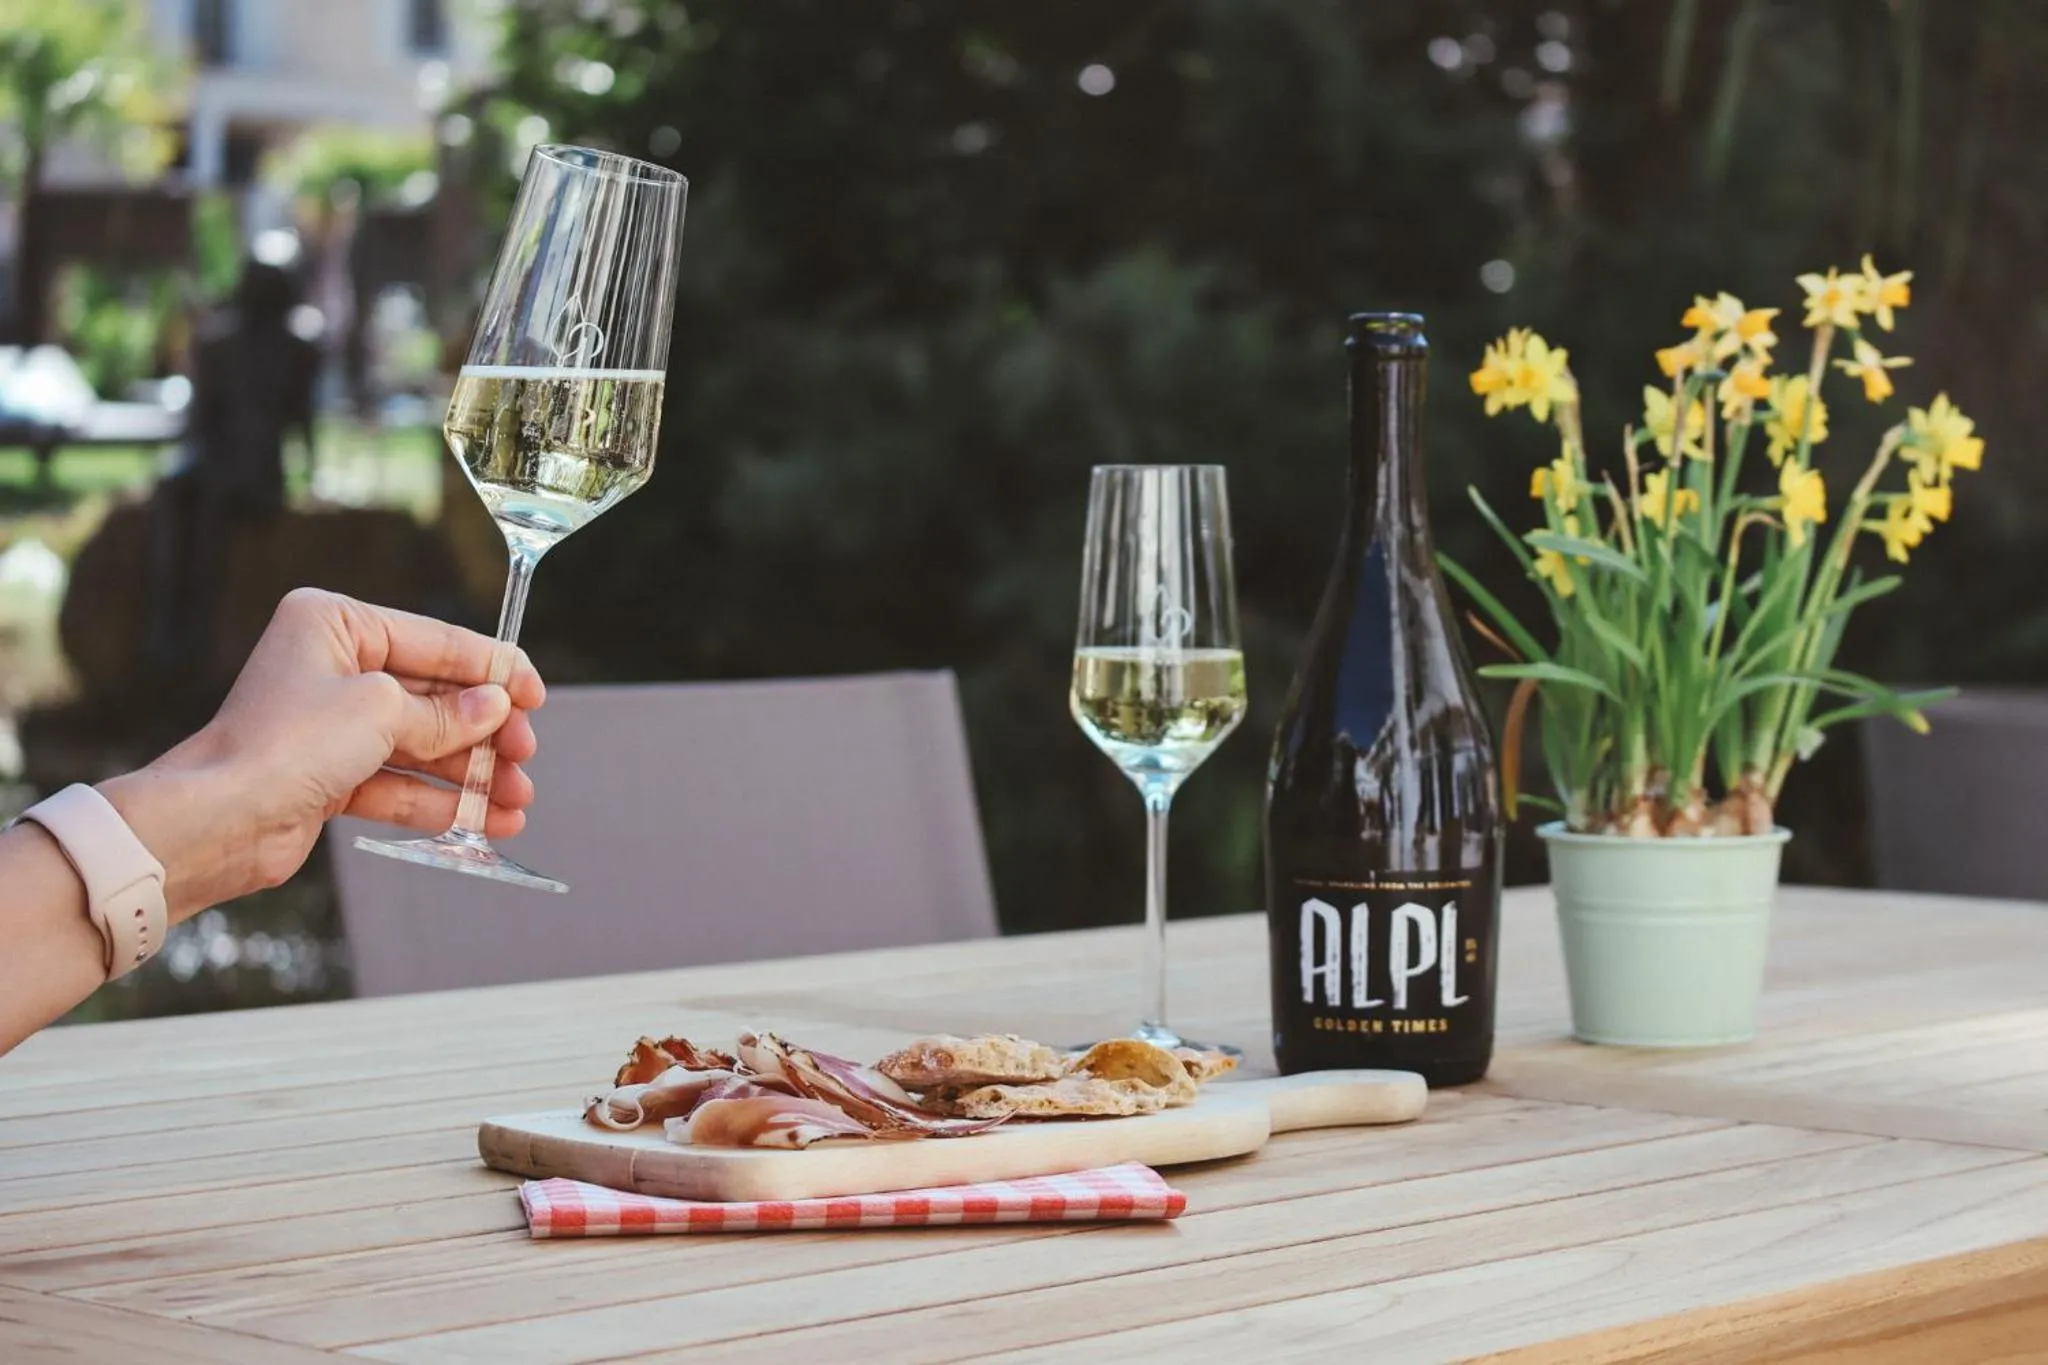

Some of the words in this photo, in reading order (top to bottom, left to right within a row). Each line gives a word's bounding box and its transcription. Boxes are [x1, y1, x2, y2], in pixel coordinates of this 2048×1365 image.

[1300, 897, 1470, 1010] ALPL
[1313, 1016, 1383, 1033] GOLDEN
[1391, 1018, 1448, 1033] TIMES
